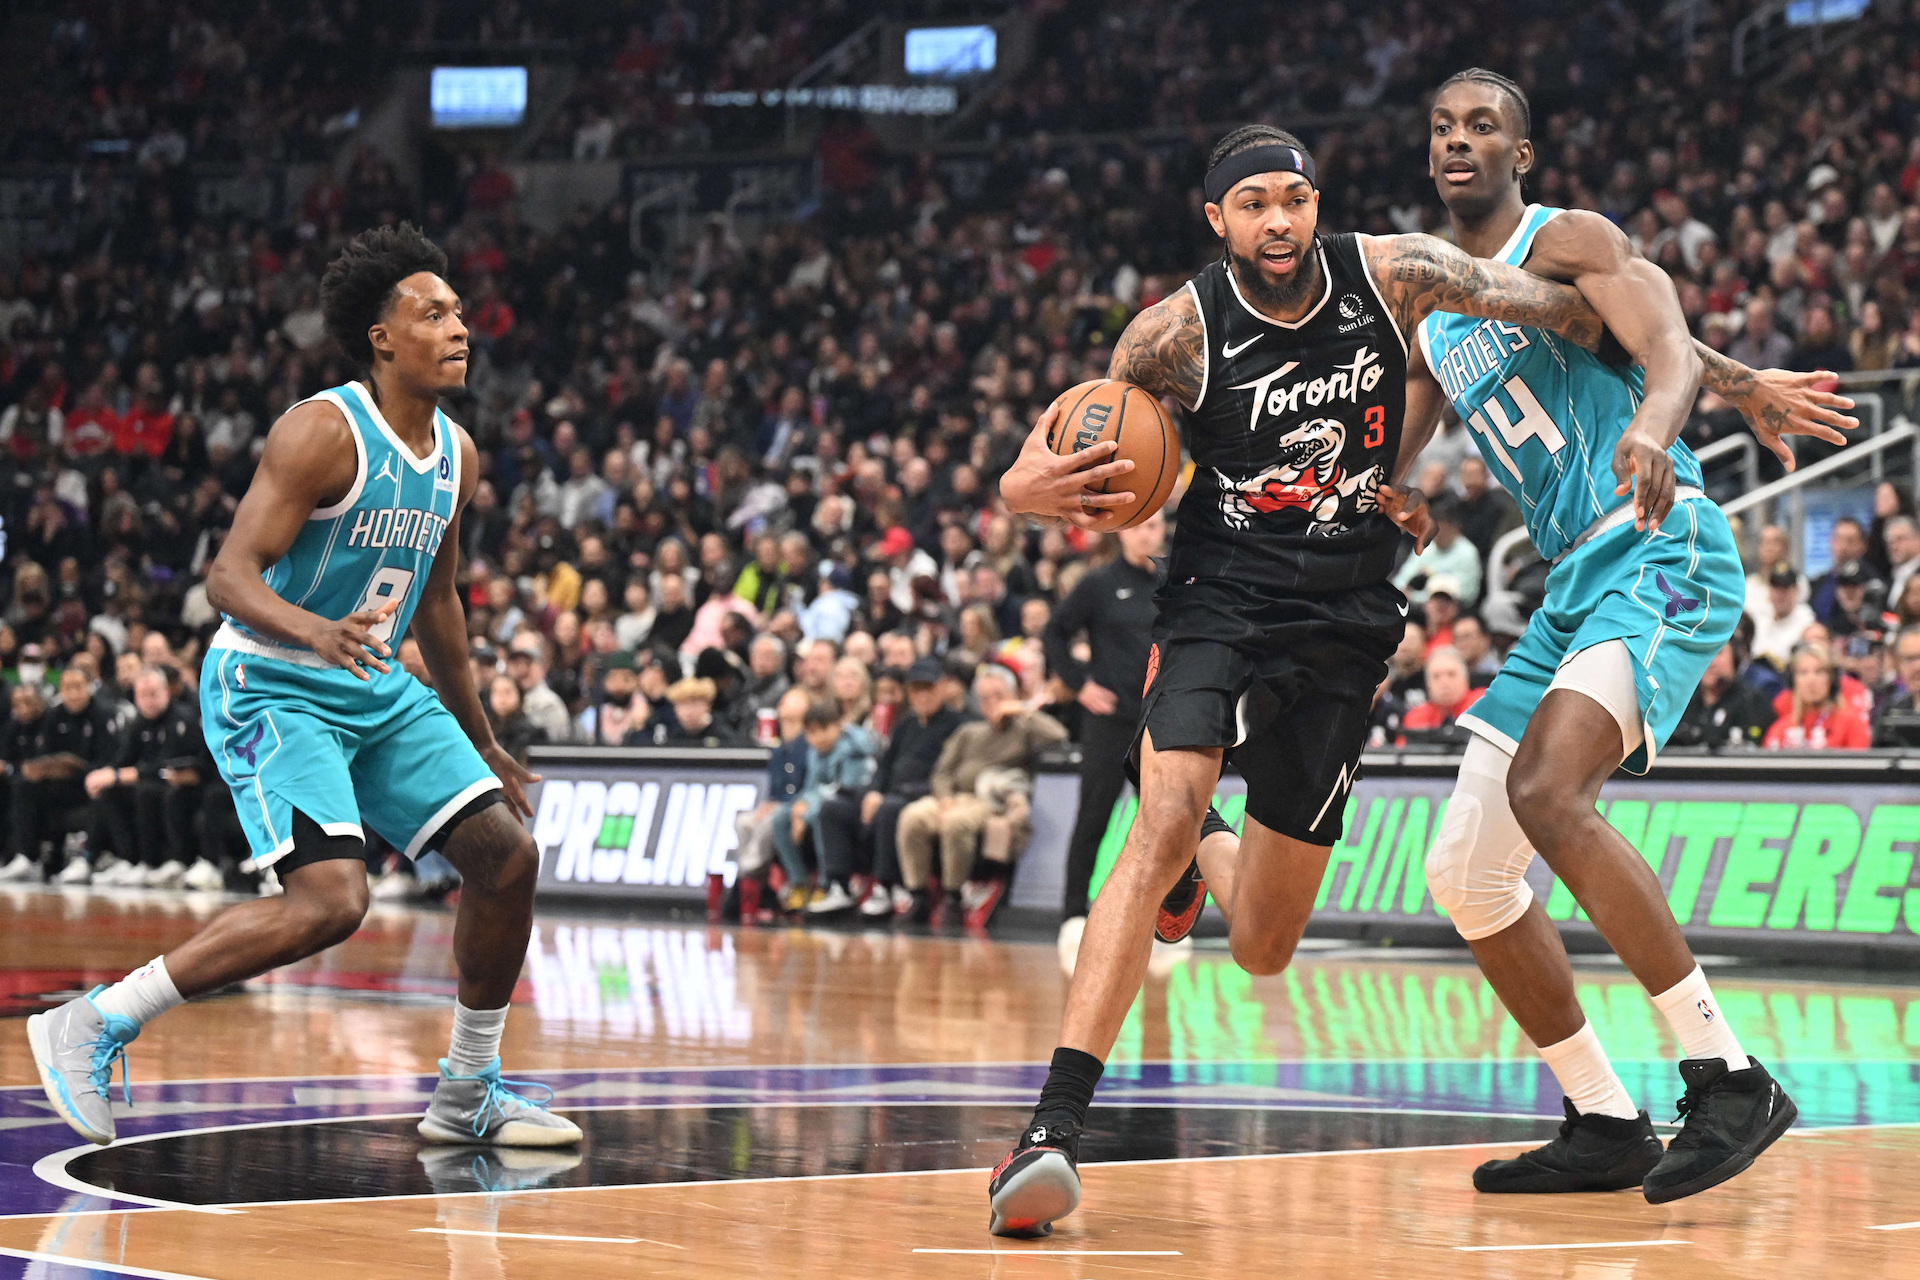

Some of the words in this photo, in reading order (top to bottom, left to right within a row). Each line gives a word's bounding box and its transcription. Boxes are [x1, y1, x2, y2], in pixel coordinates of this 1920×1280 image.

[1338, 322, 1358, 334] Sun
[1356, 313, 1376, 327] Life
[1226, 345, 1385, 432] Toronto
[1363, 404, 1386, 450] 3
[1467, 373, 1569, 486] 14
[347, 507, 449, 559] HORNETS
[356, 566, 415, 643] 8
[531, 780, 758, 888] PROLINE
